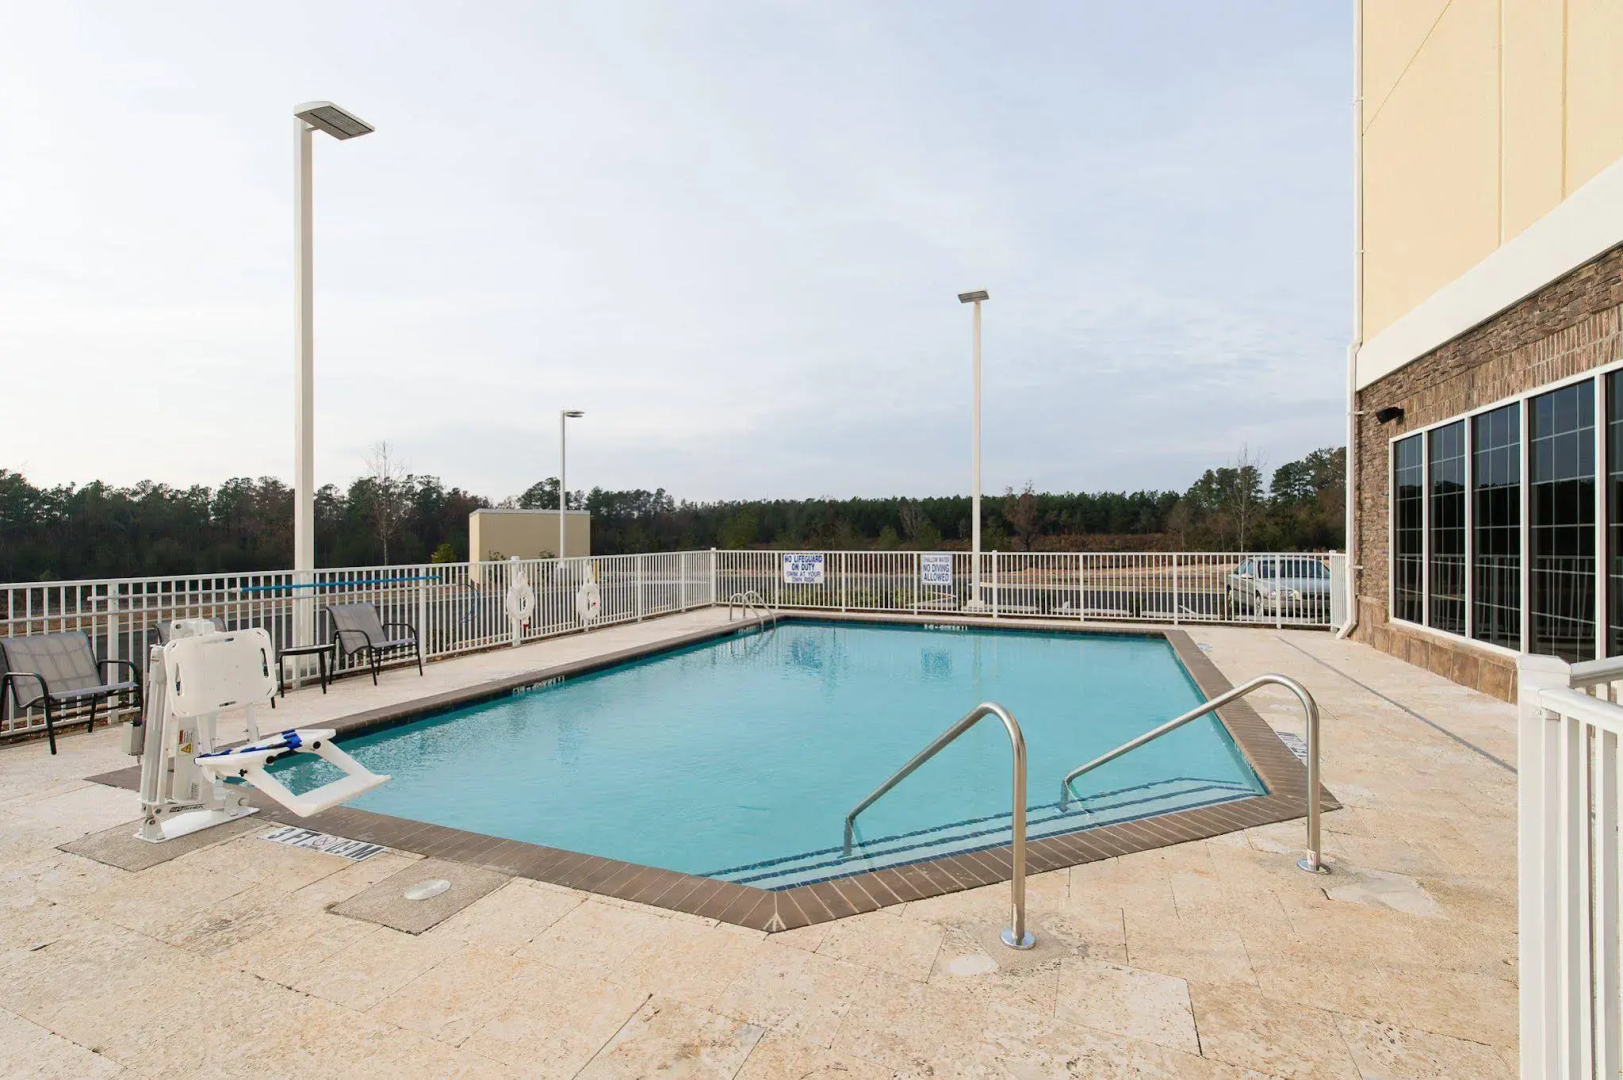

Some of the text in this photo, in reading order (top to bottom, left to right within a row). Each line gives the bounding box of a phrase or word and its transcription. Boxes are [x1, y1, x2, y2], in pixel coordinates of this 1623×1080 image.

[923, 564, 950, 572] NO DIVING
[924, 573, 950, 582] ALLOWED
